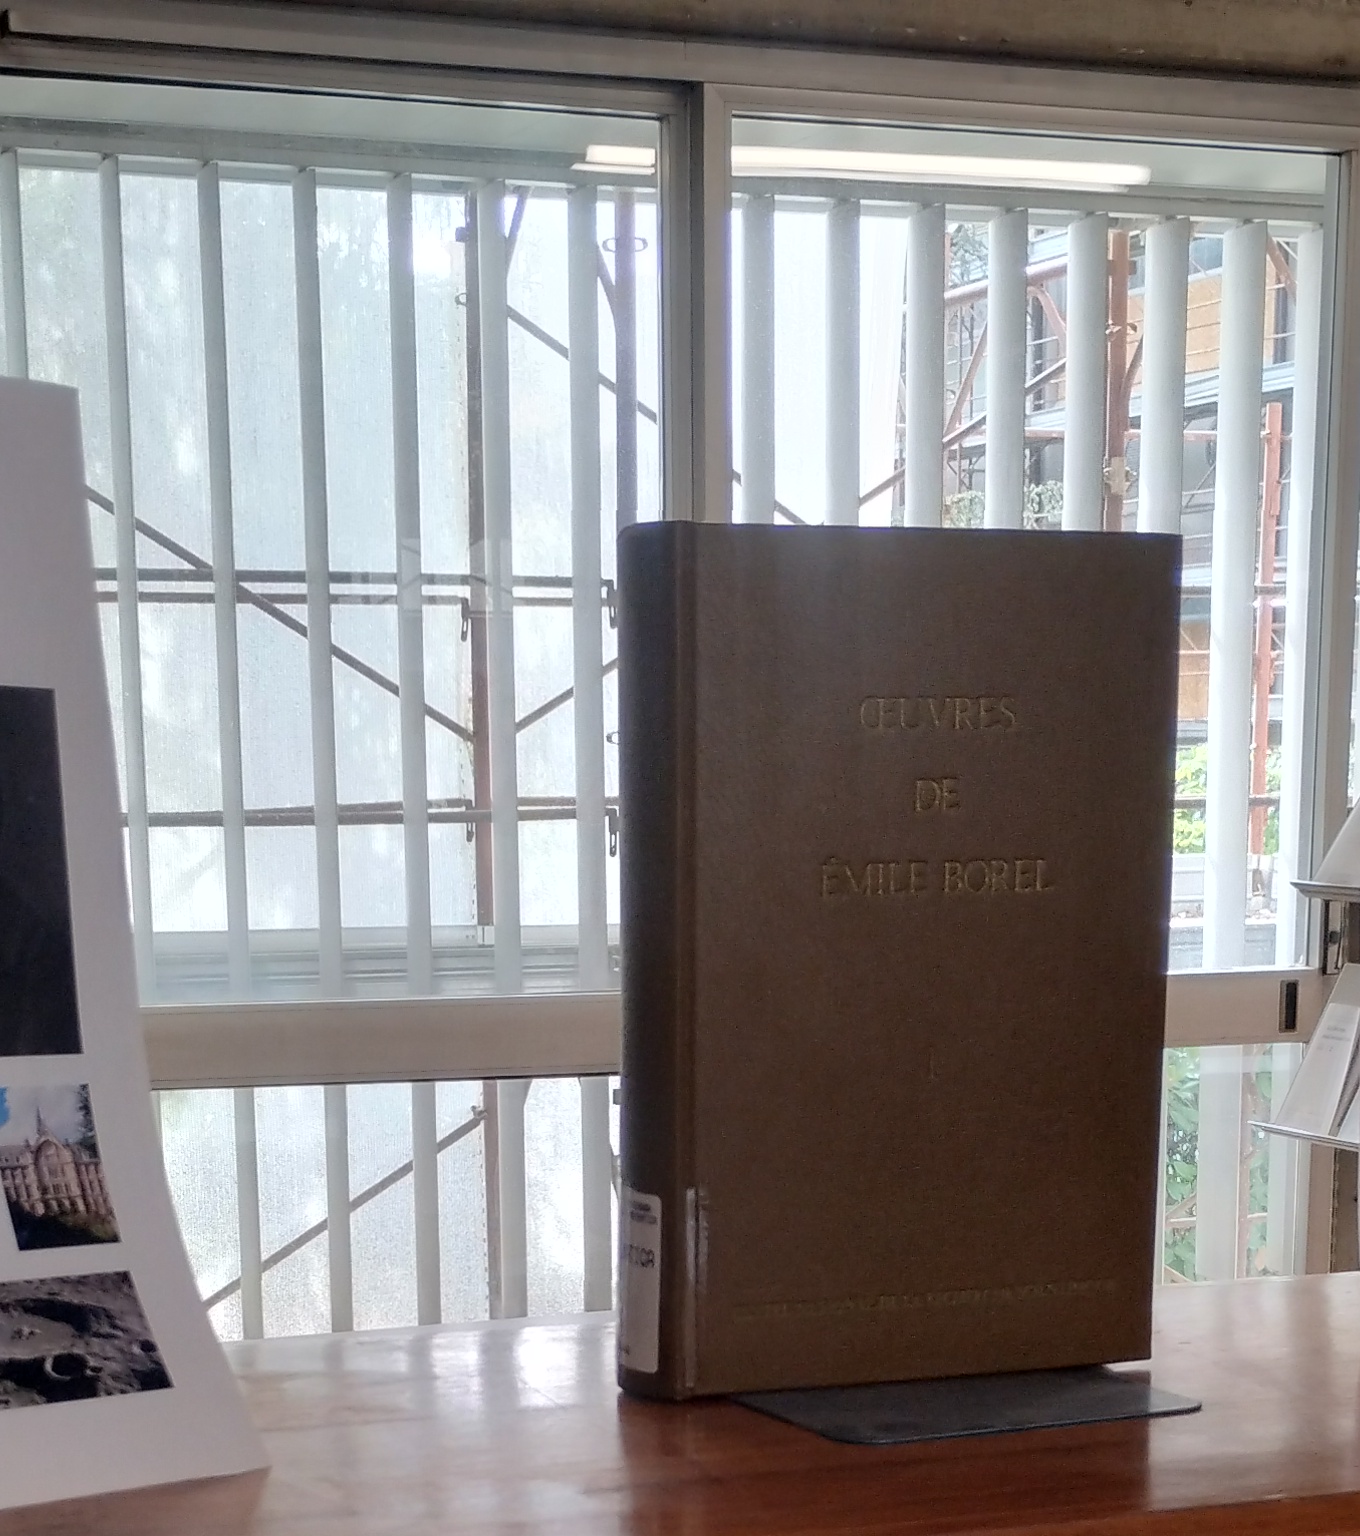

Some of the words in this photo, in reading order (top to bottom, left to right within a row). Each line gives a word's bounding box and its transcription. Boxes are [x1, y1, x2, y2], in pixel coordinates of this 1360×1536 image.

[913, 777, 961, 814] DE
[820, 855, 928, 899] ÉMILE
[943, 857, 1052, 893] BOREL
